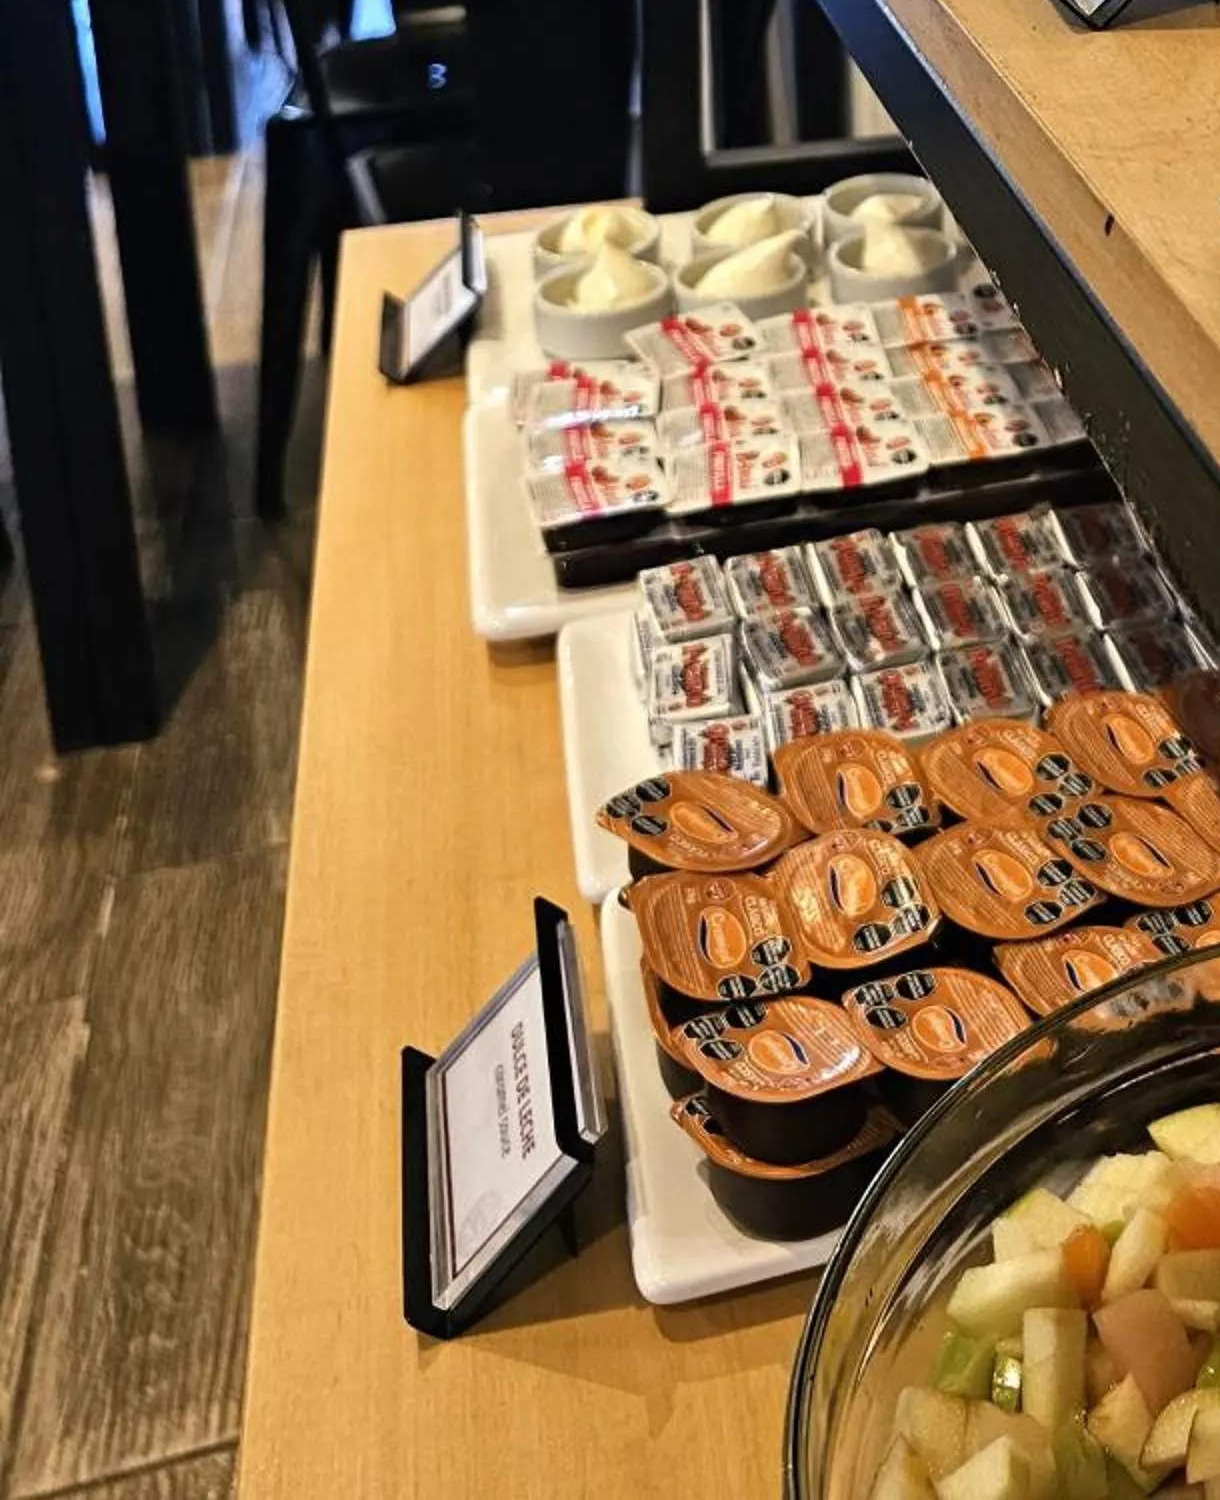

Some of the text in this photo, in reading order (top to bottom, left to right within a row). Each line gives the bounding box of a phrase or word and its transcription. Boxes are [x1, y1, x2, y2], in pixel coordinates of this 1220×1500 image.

[511, 1020, 536, 1161] DULCE DE LECHE
